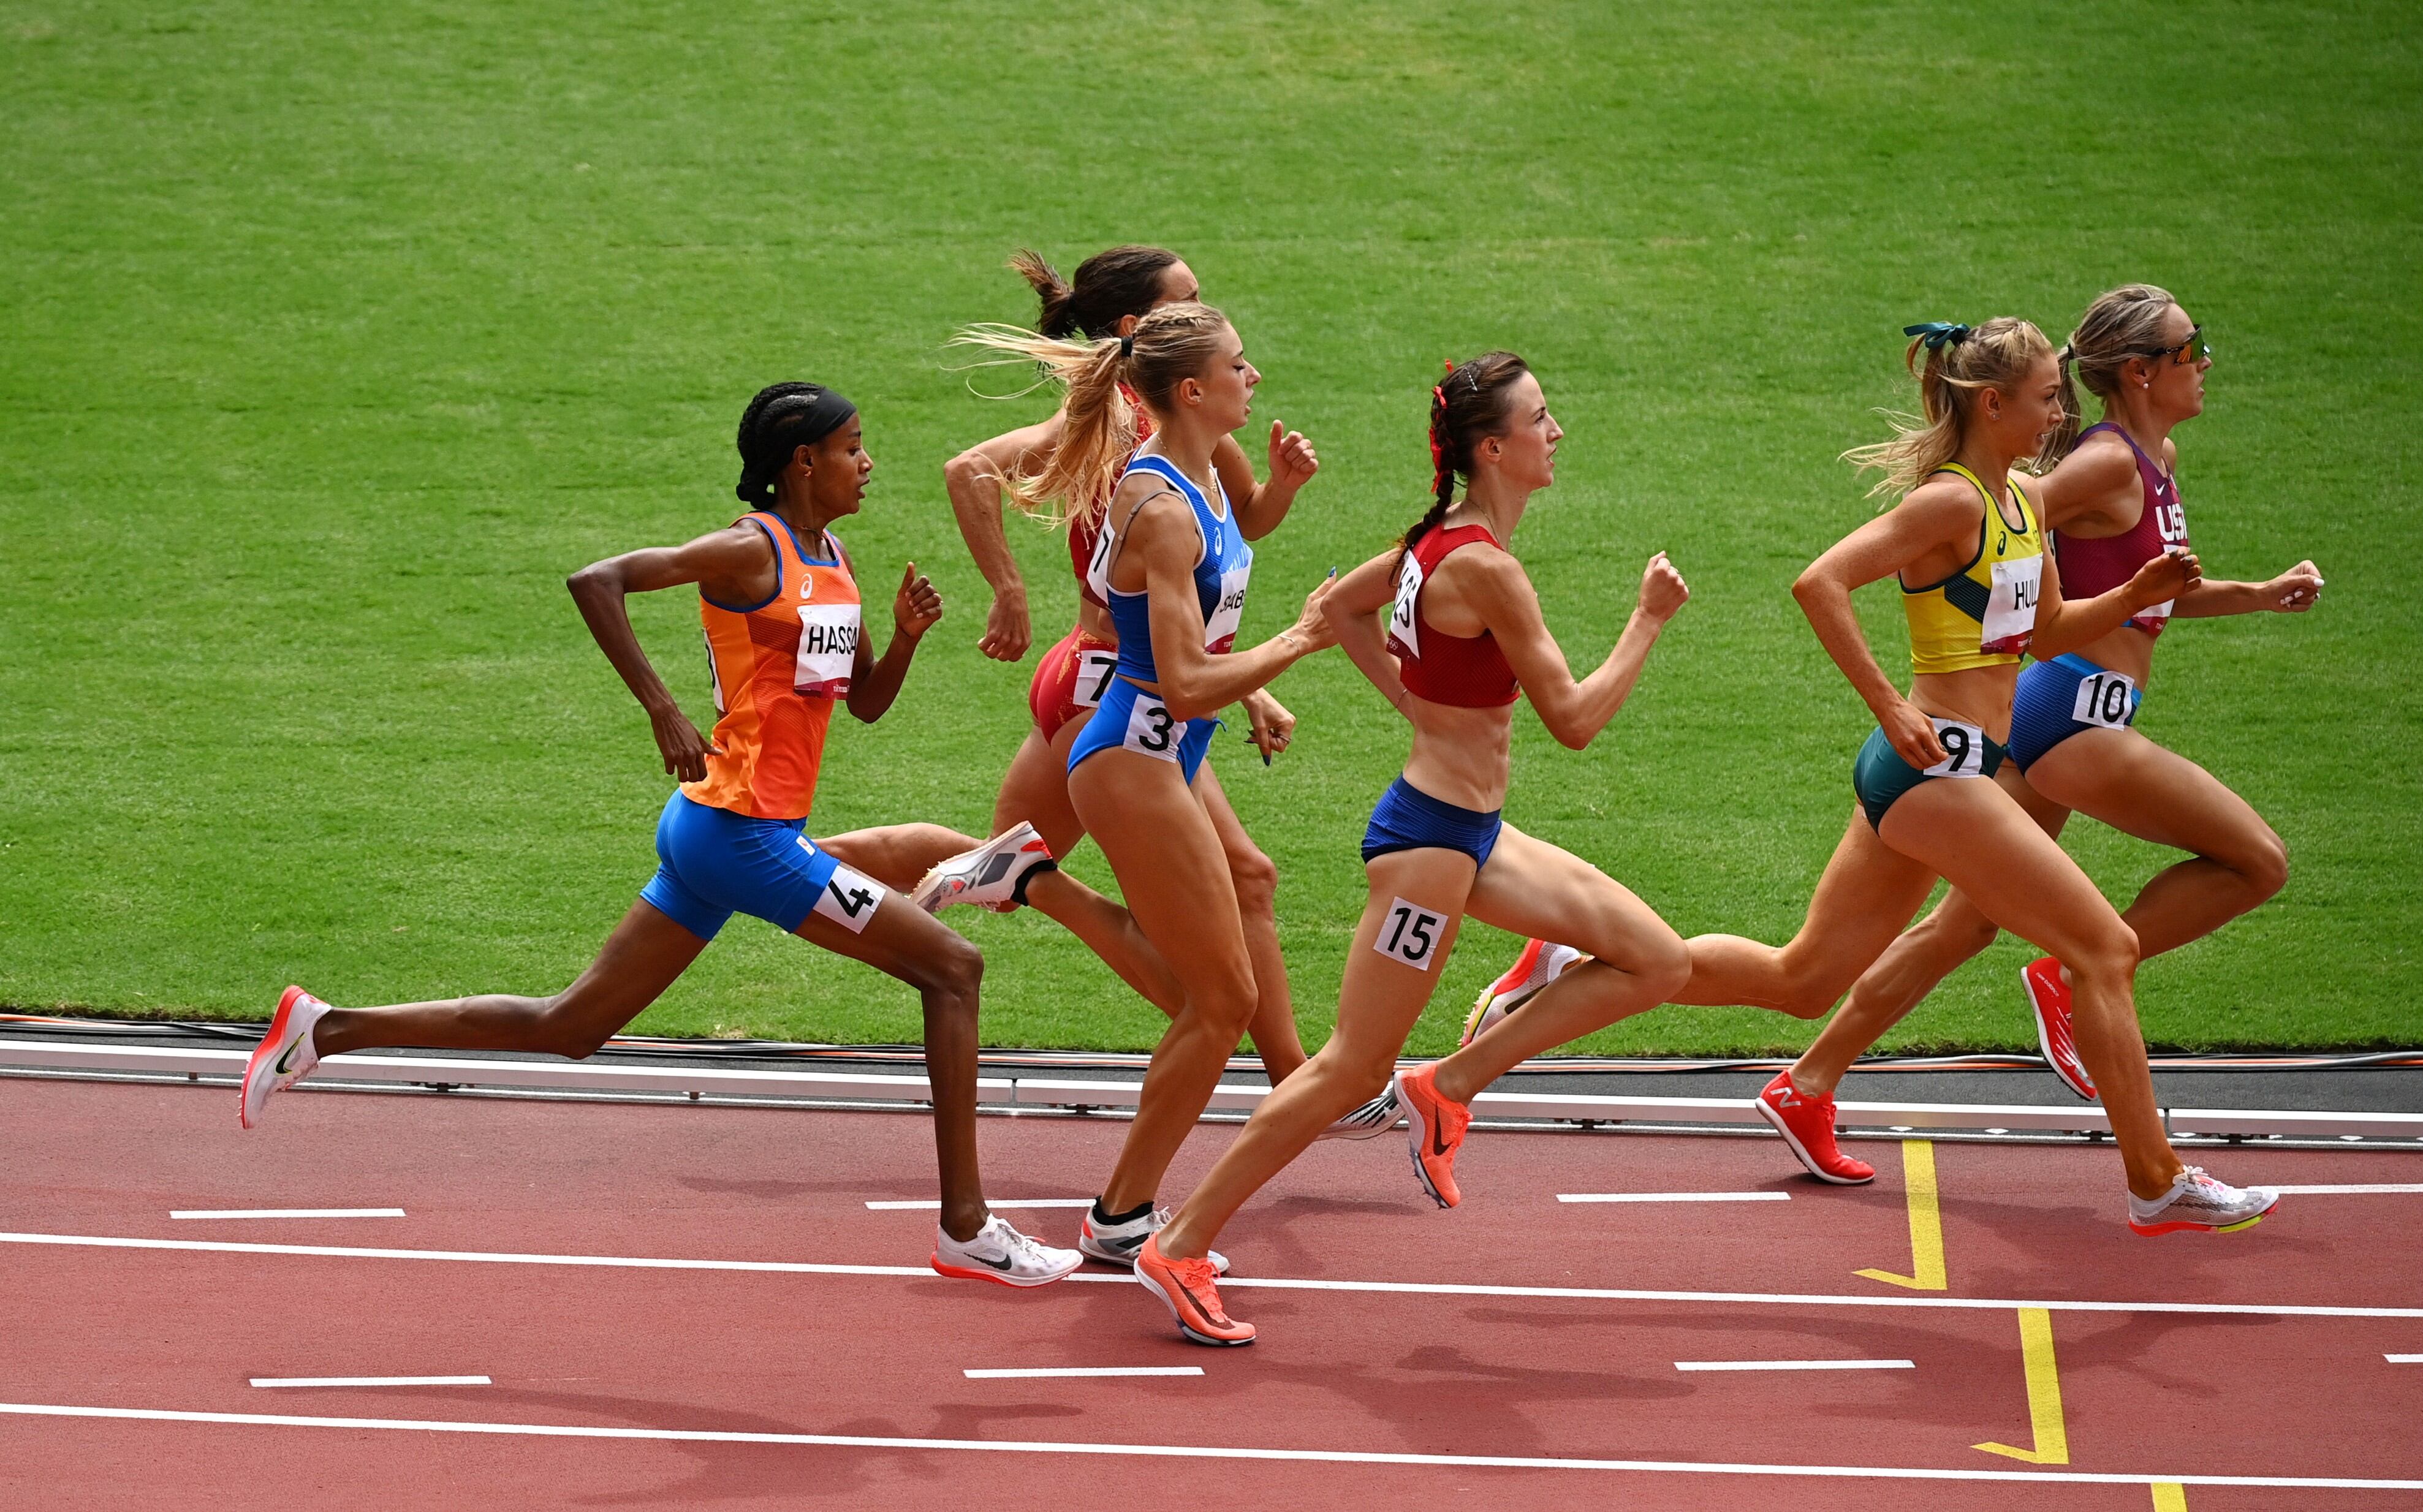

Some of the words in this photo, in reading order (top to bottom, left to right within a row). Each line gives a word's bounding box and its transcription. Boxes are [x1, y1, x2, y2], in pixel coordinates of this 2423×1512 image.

[1090, 657, 1118, 701] 7
[2088, 675, 2126, 723] 10
[1139, 707, 1175, 751] 3
[1939, 727, 1970, 772] 9
[828, 879, 874, 918] 4
[1387, 907, 1438, 961] 15
